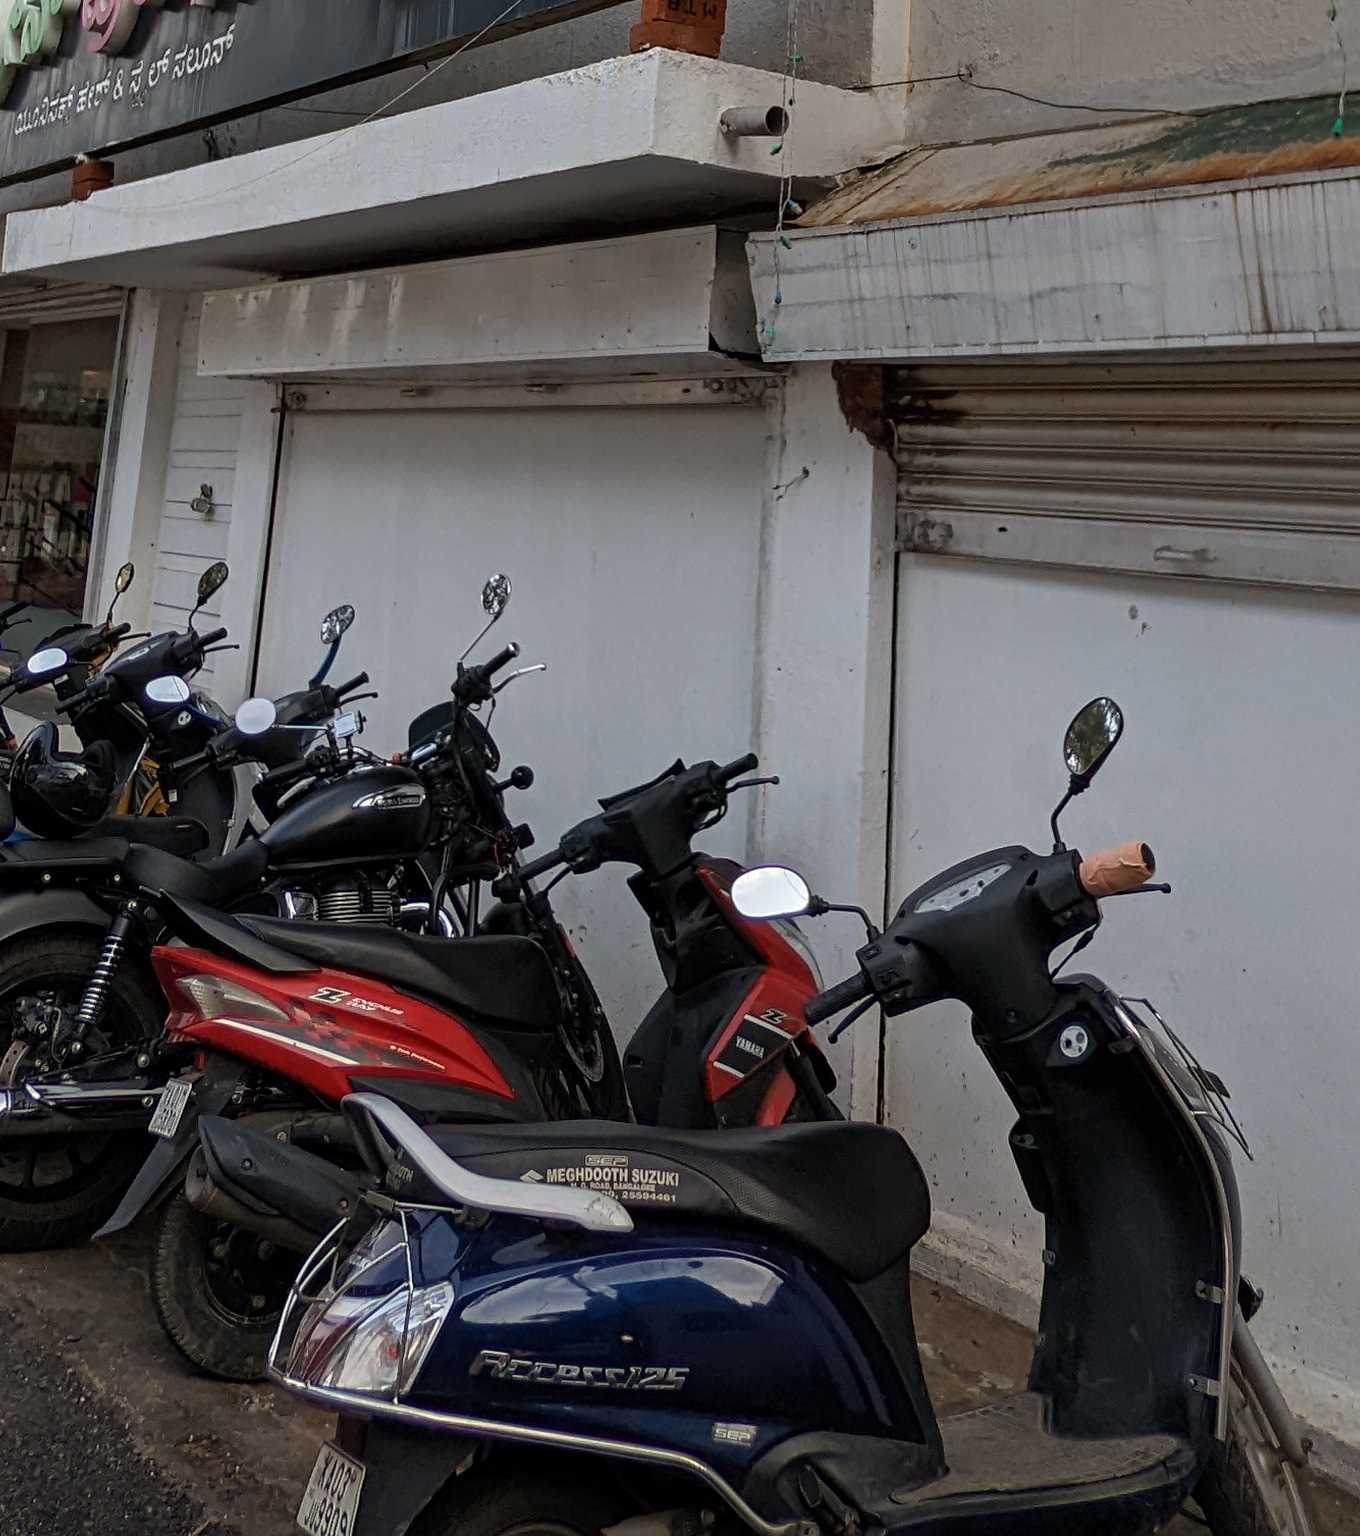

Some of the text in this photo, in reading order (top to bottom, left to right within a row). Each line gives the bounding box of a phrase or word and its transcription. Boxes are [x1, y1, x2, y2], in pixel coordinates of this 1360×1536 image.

[735, 1036, 765, 1058] YAMAHA
[546, 1167, 680, 1187] MEGHDOOTH SUZUKI
